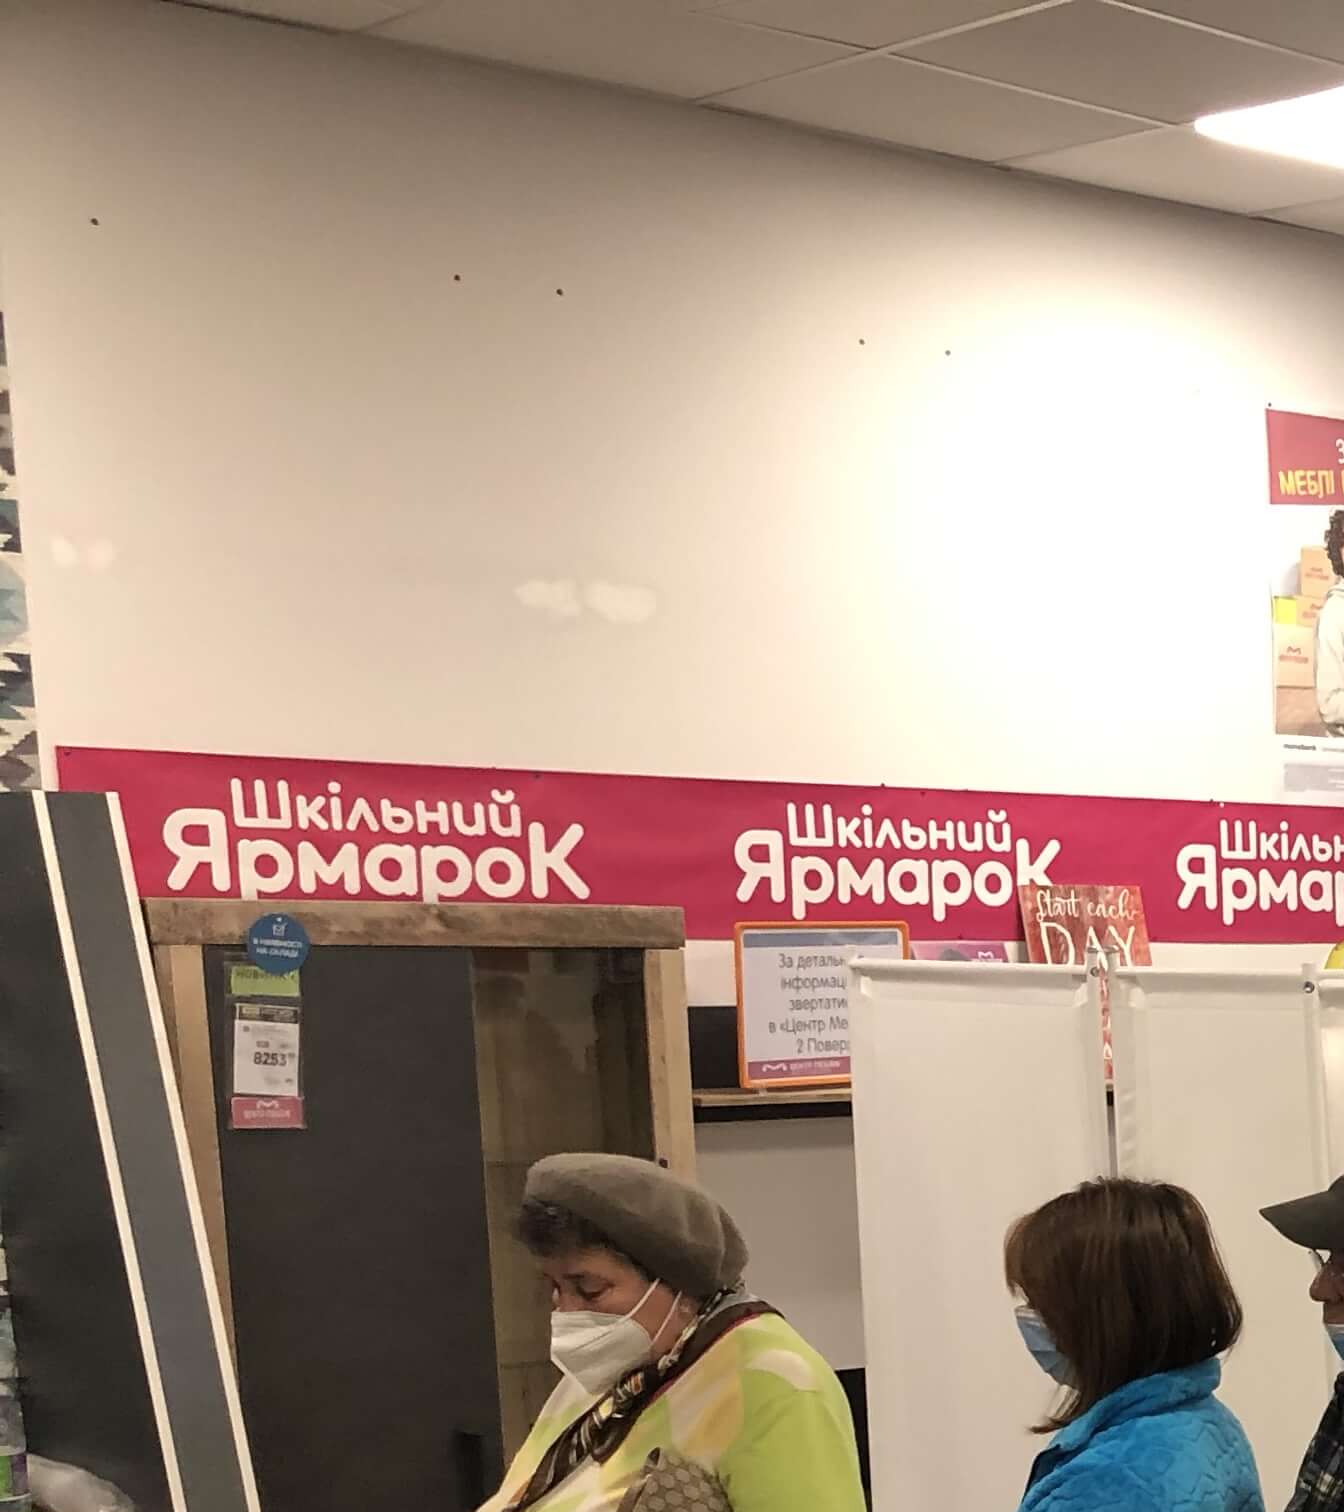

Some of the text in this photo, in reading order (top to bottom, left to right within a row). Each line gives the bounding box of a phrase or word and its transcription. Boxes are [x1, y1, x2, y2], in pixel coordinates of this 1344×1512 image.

[1279, 469, 1335, 498] МЕБЛІ
[230, 777, 522, 840] Шкільний
[786, 802, 1012, 854] Шкільний
[161, 806, 591, 902] ЯрмароК
[734, 830, 1062, 922] ЯрмароК
[1035, 888, 1138, 922] Start each
[779, 953, 795, 969] За
[1040, 921, 1135, 968] DAY
[797, 1038, 850, 1054] 2 Повер
